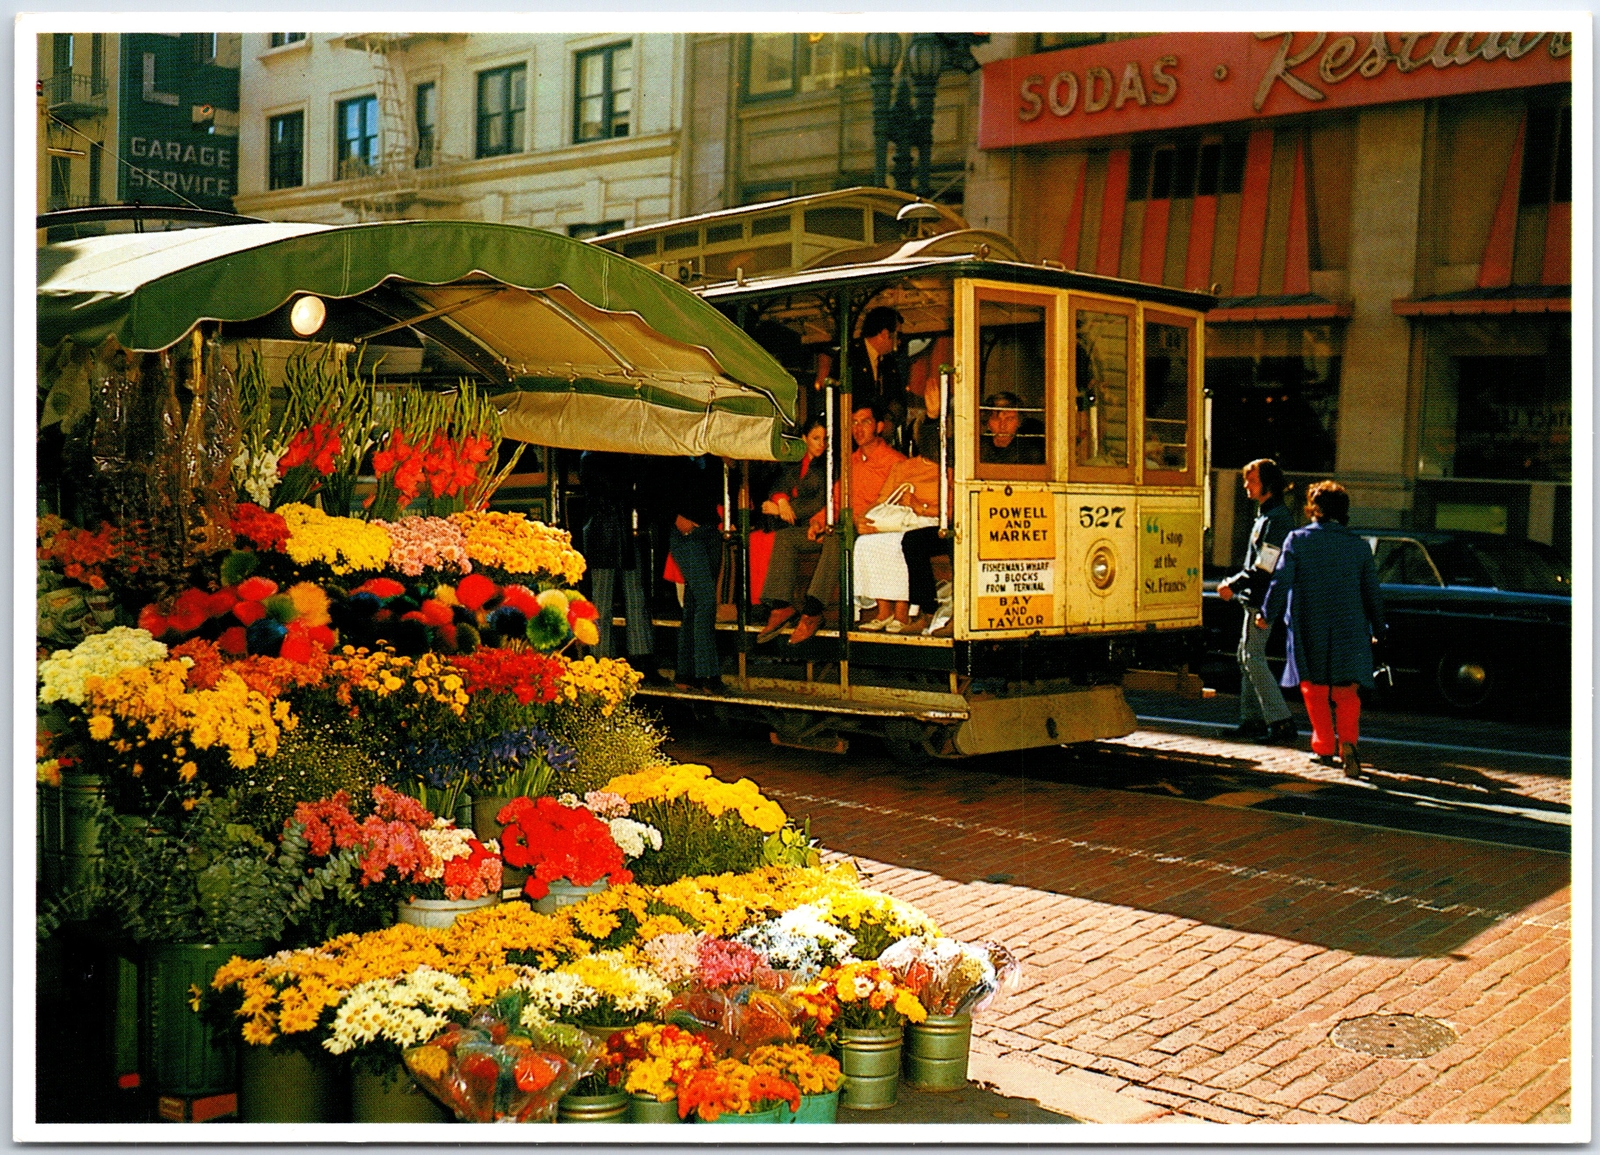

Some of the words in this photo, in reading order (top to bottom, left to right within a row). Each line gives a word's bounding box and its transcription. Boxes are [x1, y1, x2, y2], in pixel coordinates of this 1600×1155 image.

[1019, 55, 1178, 122] SODAS
[131, 136, 231, 169] GARAGE
[129, 167, 231, 197] SERVICE
[989, 507, 1048, 519] POWELL
[1079, 505, 1126, 528] 527
[1005, 520, 1031, 529] AND
[989, 530, 1048, 542] MARKET
[1166, 532, 1183, 548] stop
[1026, 561, 1050, 572] WHARF
[1154, 556, 1163, 568] at
[1164, 553, 1178, 568] the
[994, 573, 1000, 582] 3
[1005, 572, 1039, 582] BLOCKS
[986, 584, 1006, 593] FROM
[1013, 582, 1046, 592] TERMINAL
[999, 595, 1033, 606] BAY
[1004, 606, 1028, 616] AND
[987, 614, 1045, 628] TAYLOR
